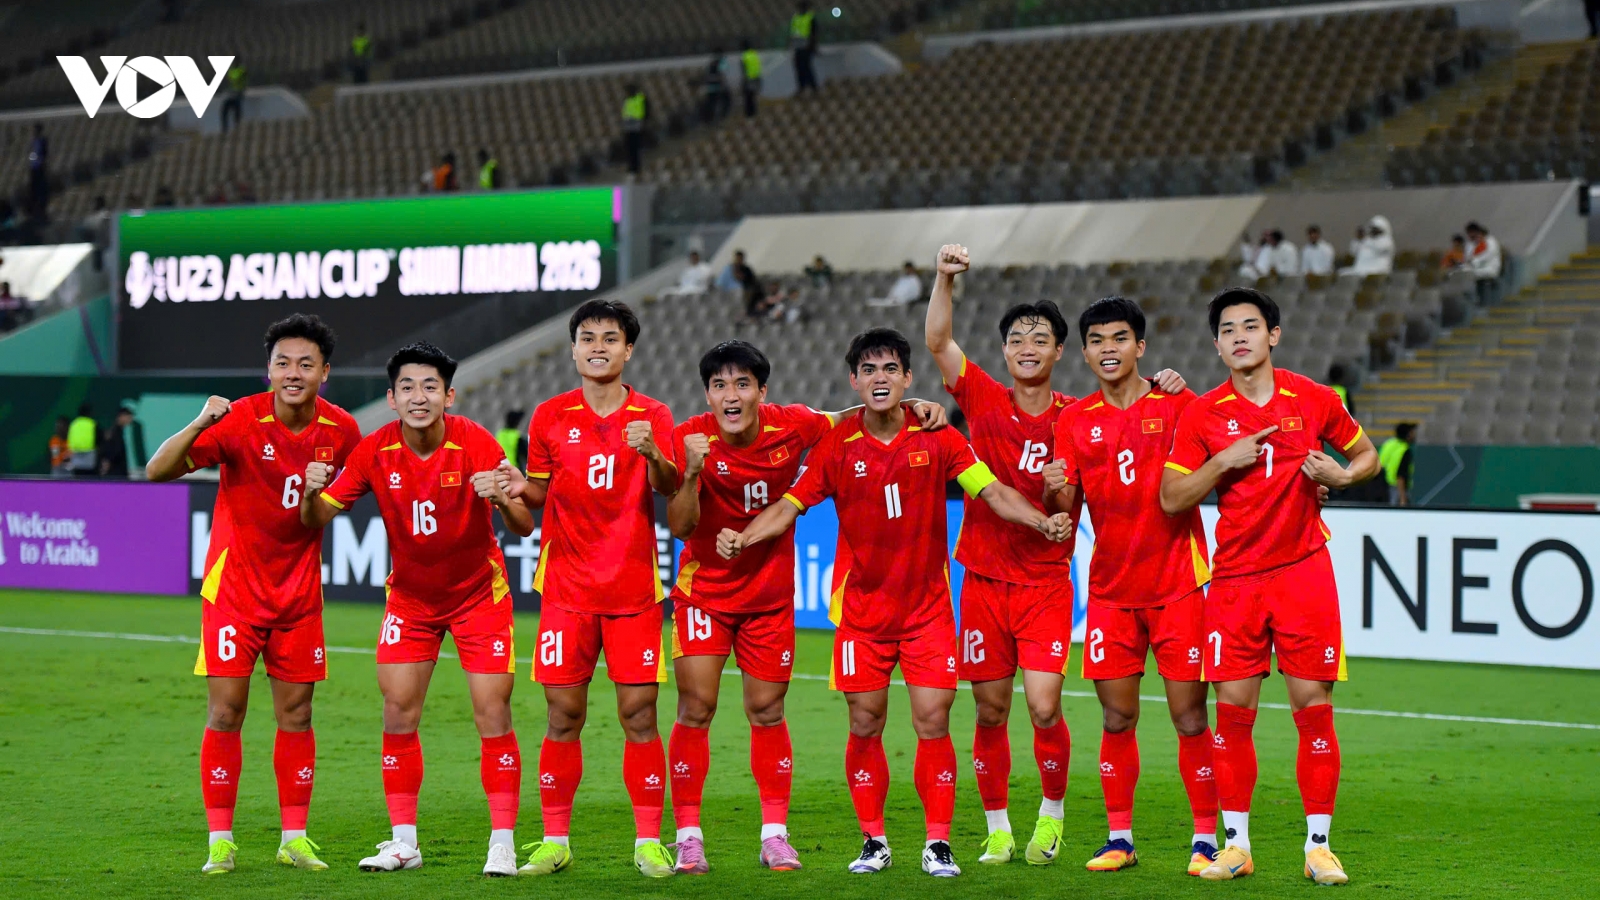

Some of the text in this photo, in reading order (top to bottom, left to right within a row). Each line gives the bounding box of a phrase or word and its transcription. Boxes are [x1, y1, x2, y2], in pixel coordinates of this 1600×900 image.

[167, 255, 225, 302] U23
[224, 251, 321, 300] ASIAN
[321, 249, 391, 298] CUP
[588, 454, 614, 489] 21
[1018, 439, 1048, 474] 12
[1118, 449, 1135, 485] 2
[282, 474, 302, 509] 6
[744, 480, 768, 513] 19
[885, 483, 902, 519] 11
[6, 511, 86, 539] Welcome
[413, 500, 437, 535] 16
[20, 540, 99, 566] to Arabia
[1362, 534, 1594, 640] NEO
[380, 612, 403, 645] 16
[688, 607, 711, 641] 19
[219, 625, 236, 661] 6
[541, 630, 562, 666] 21
[843, 641, 855, 676] 11
[964, 629, 985, 664] 12
[1090, 628, 1105, 664] 2
[1209, 631, 1221, 666] 7
